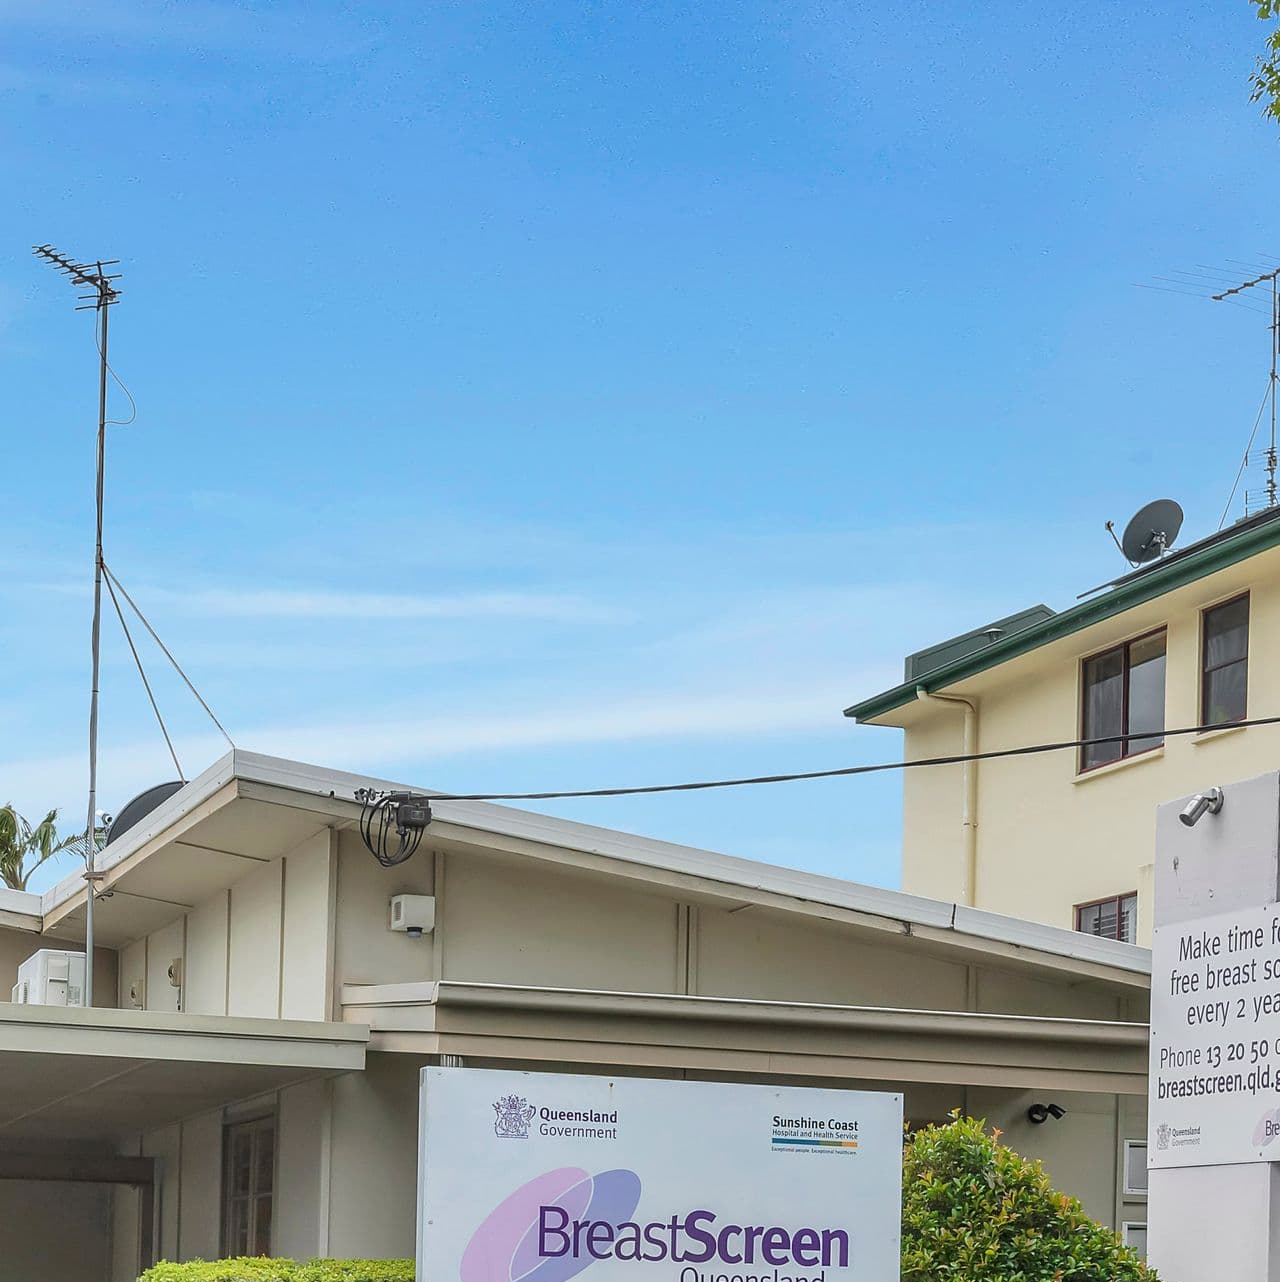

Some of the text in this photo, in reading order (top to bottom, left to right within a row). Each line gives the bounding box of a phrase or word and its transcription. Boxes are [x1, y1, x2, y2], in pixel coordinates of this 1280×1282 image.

[1179, 931, 1221, 961] Make
[1228, 925, 1264, 952] time
[1170, 970, 1199, 996] free
[1206, 959, 1256, 990] breast
[1187, 1000, 1230, 1027] every
[1236, 998, 1246, 1018] 2
[1160, 1046, 1201, 1069] Phone
[1206, 1045, 1221, 1068] 13
[1227, 1042, 1245, 1061] 20
[1250, 1039, 1269, 1064] 50
[539, 1107, 618, 1124] Queensland
[773, 1116, 859, 1131] Sunshine Coast
[539, 1123, 617, 1140] Government
[772, 1129, 858, 1140] Hospital and Health Service
[1171, 1126, 1201, 1137] Queensland
[1172, 1138, 1201, 1147] Government
[538, 1205, 849, 1268] BreastScreen
